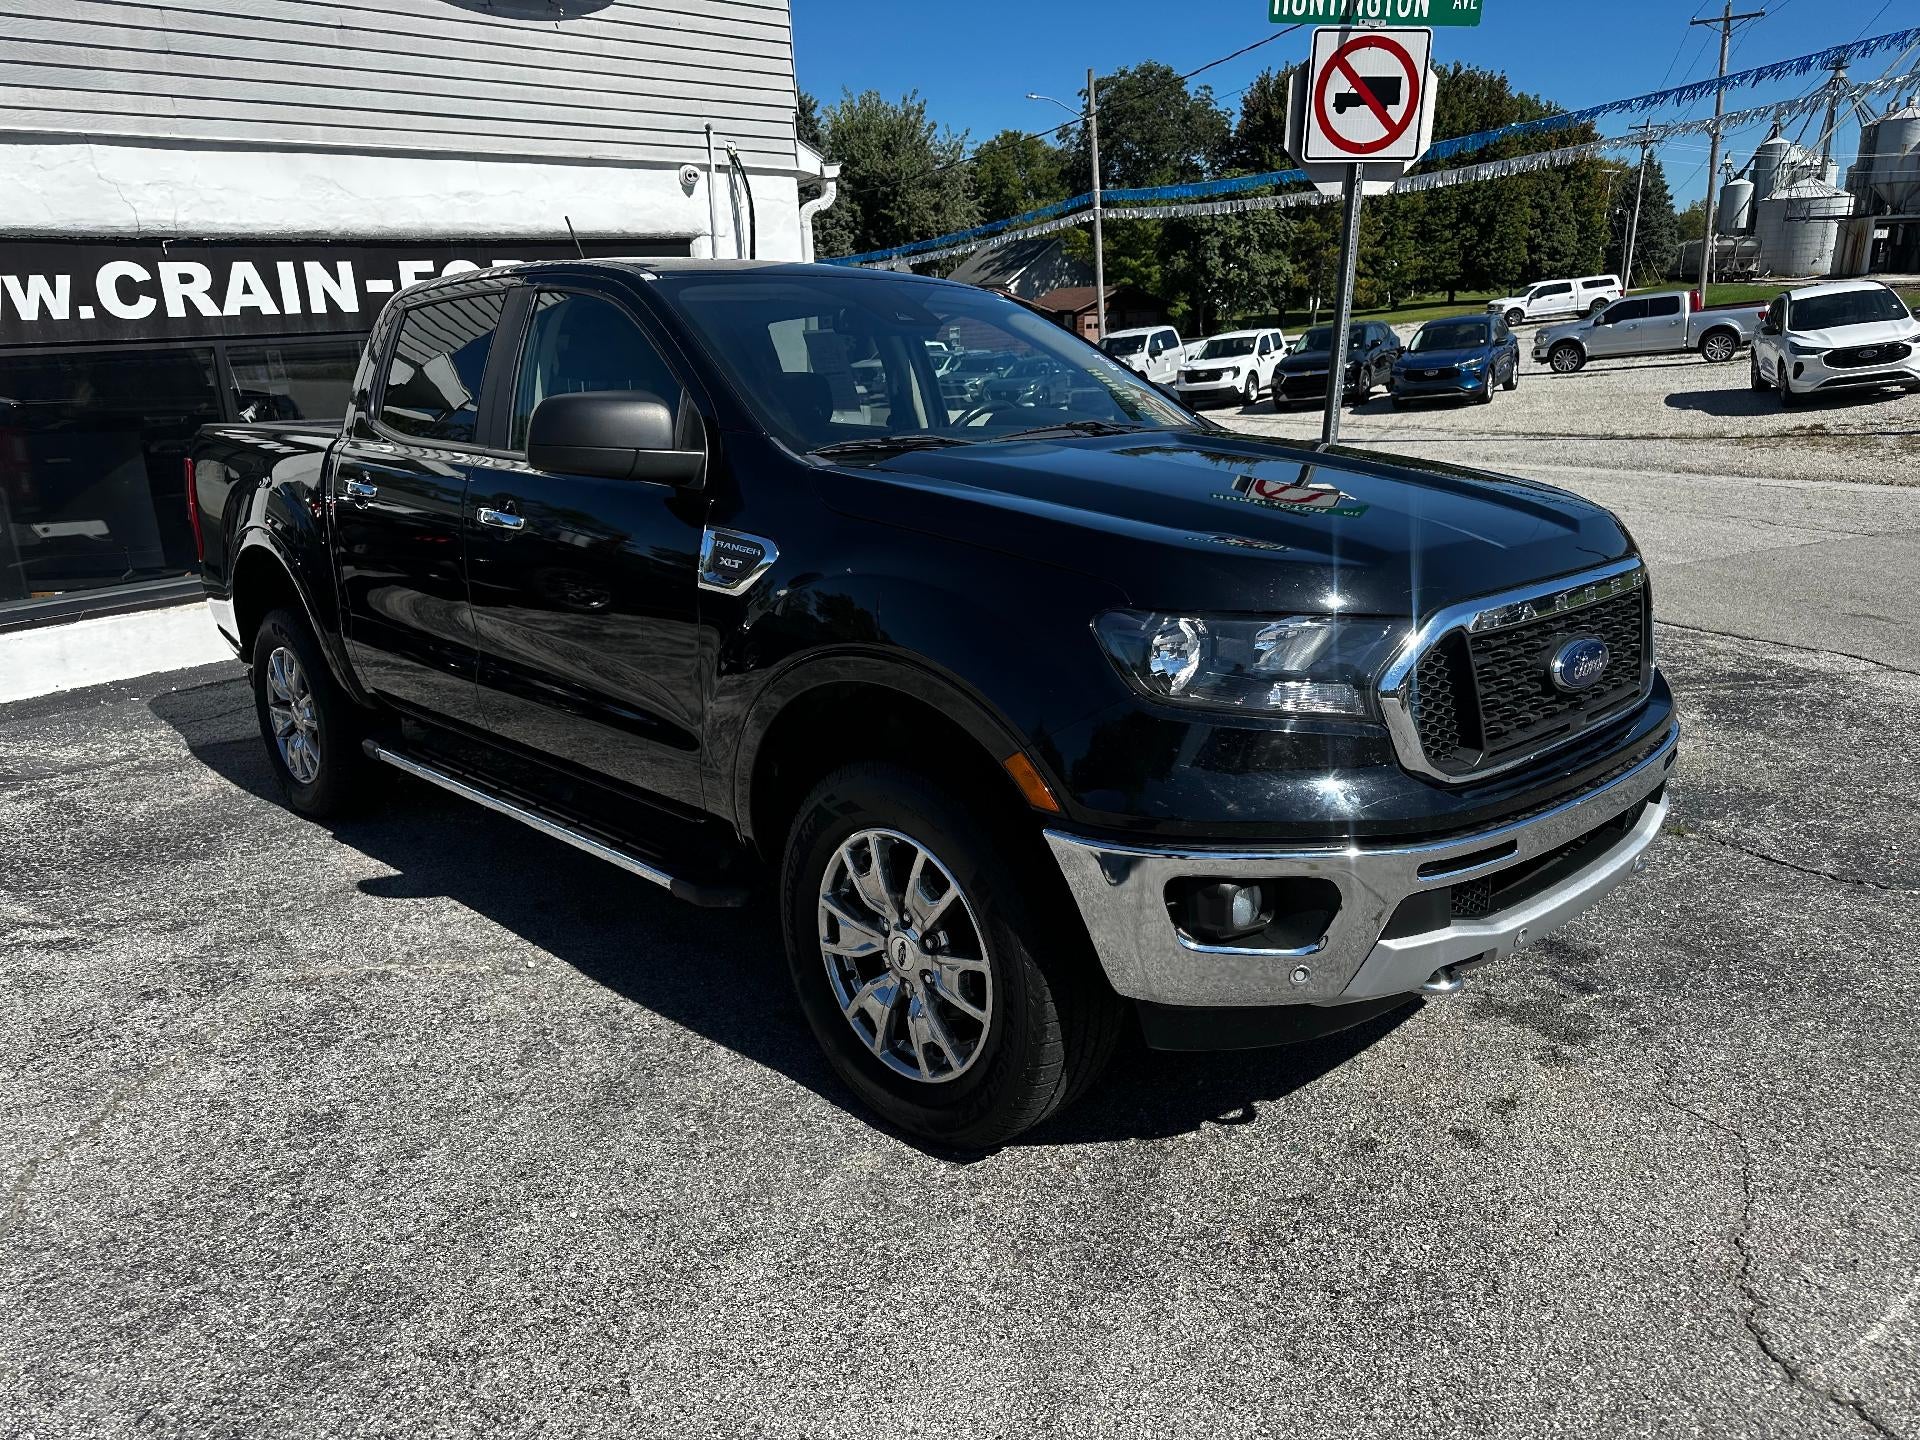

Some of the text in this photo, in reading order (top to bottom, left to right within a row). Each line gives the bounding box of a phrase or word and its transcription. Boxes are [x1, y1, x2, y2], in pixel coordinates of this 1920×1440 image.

[1452, 0, 1477, 10] AVE
[716, 540, 761, 556] RANGER
[719, 556, 743, 569] XLT
[1573, 651, 1603, 680] Ford
